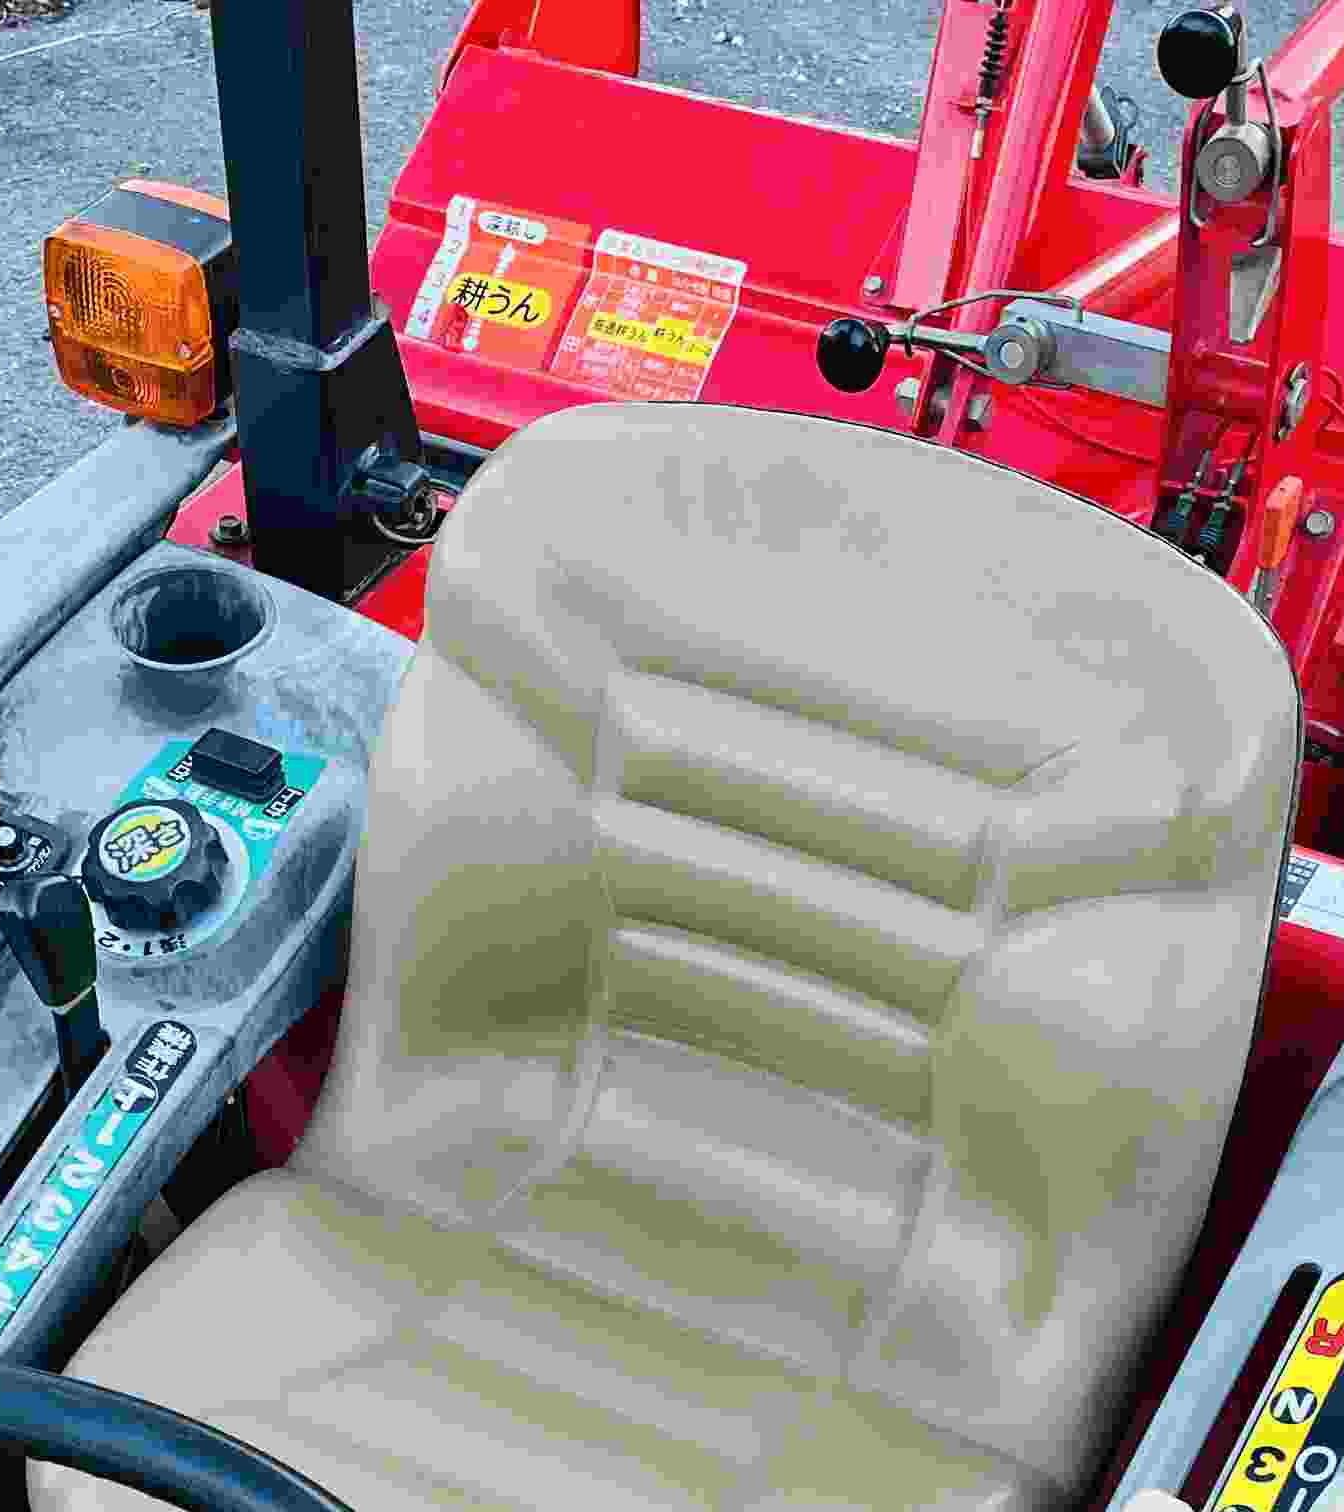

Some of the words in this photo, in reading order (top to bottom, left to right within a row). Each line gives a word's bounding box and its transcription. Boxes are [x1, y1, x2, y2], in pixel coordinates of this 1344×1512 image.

[452, 276, 541, 323] 耕うん
[62, 1151, 105, 1188] 2
[33, 1192, 73, 1231] 3
[7, 1236, 42, 1270] 4
[1245, 1444, 1286, 1484] 3
